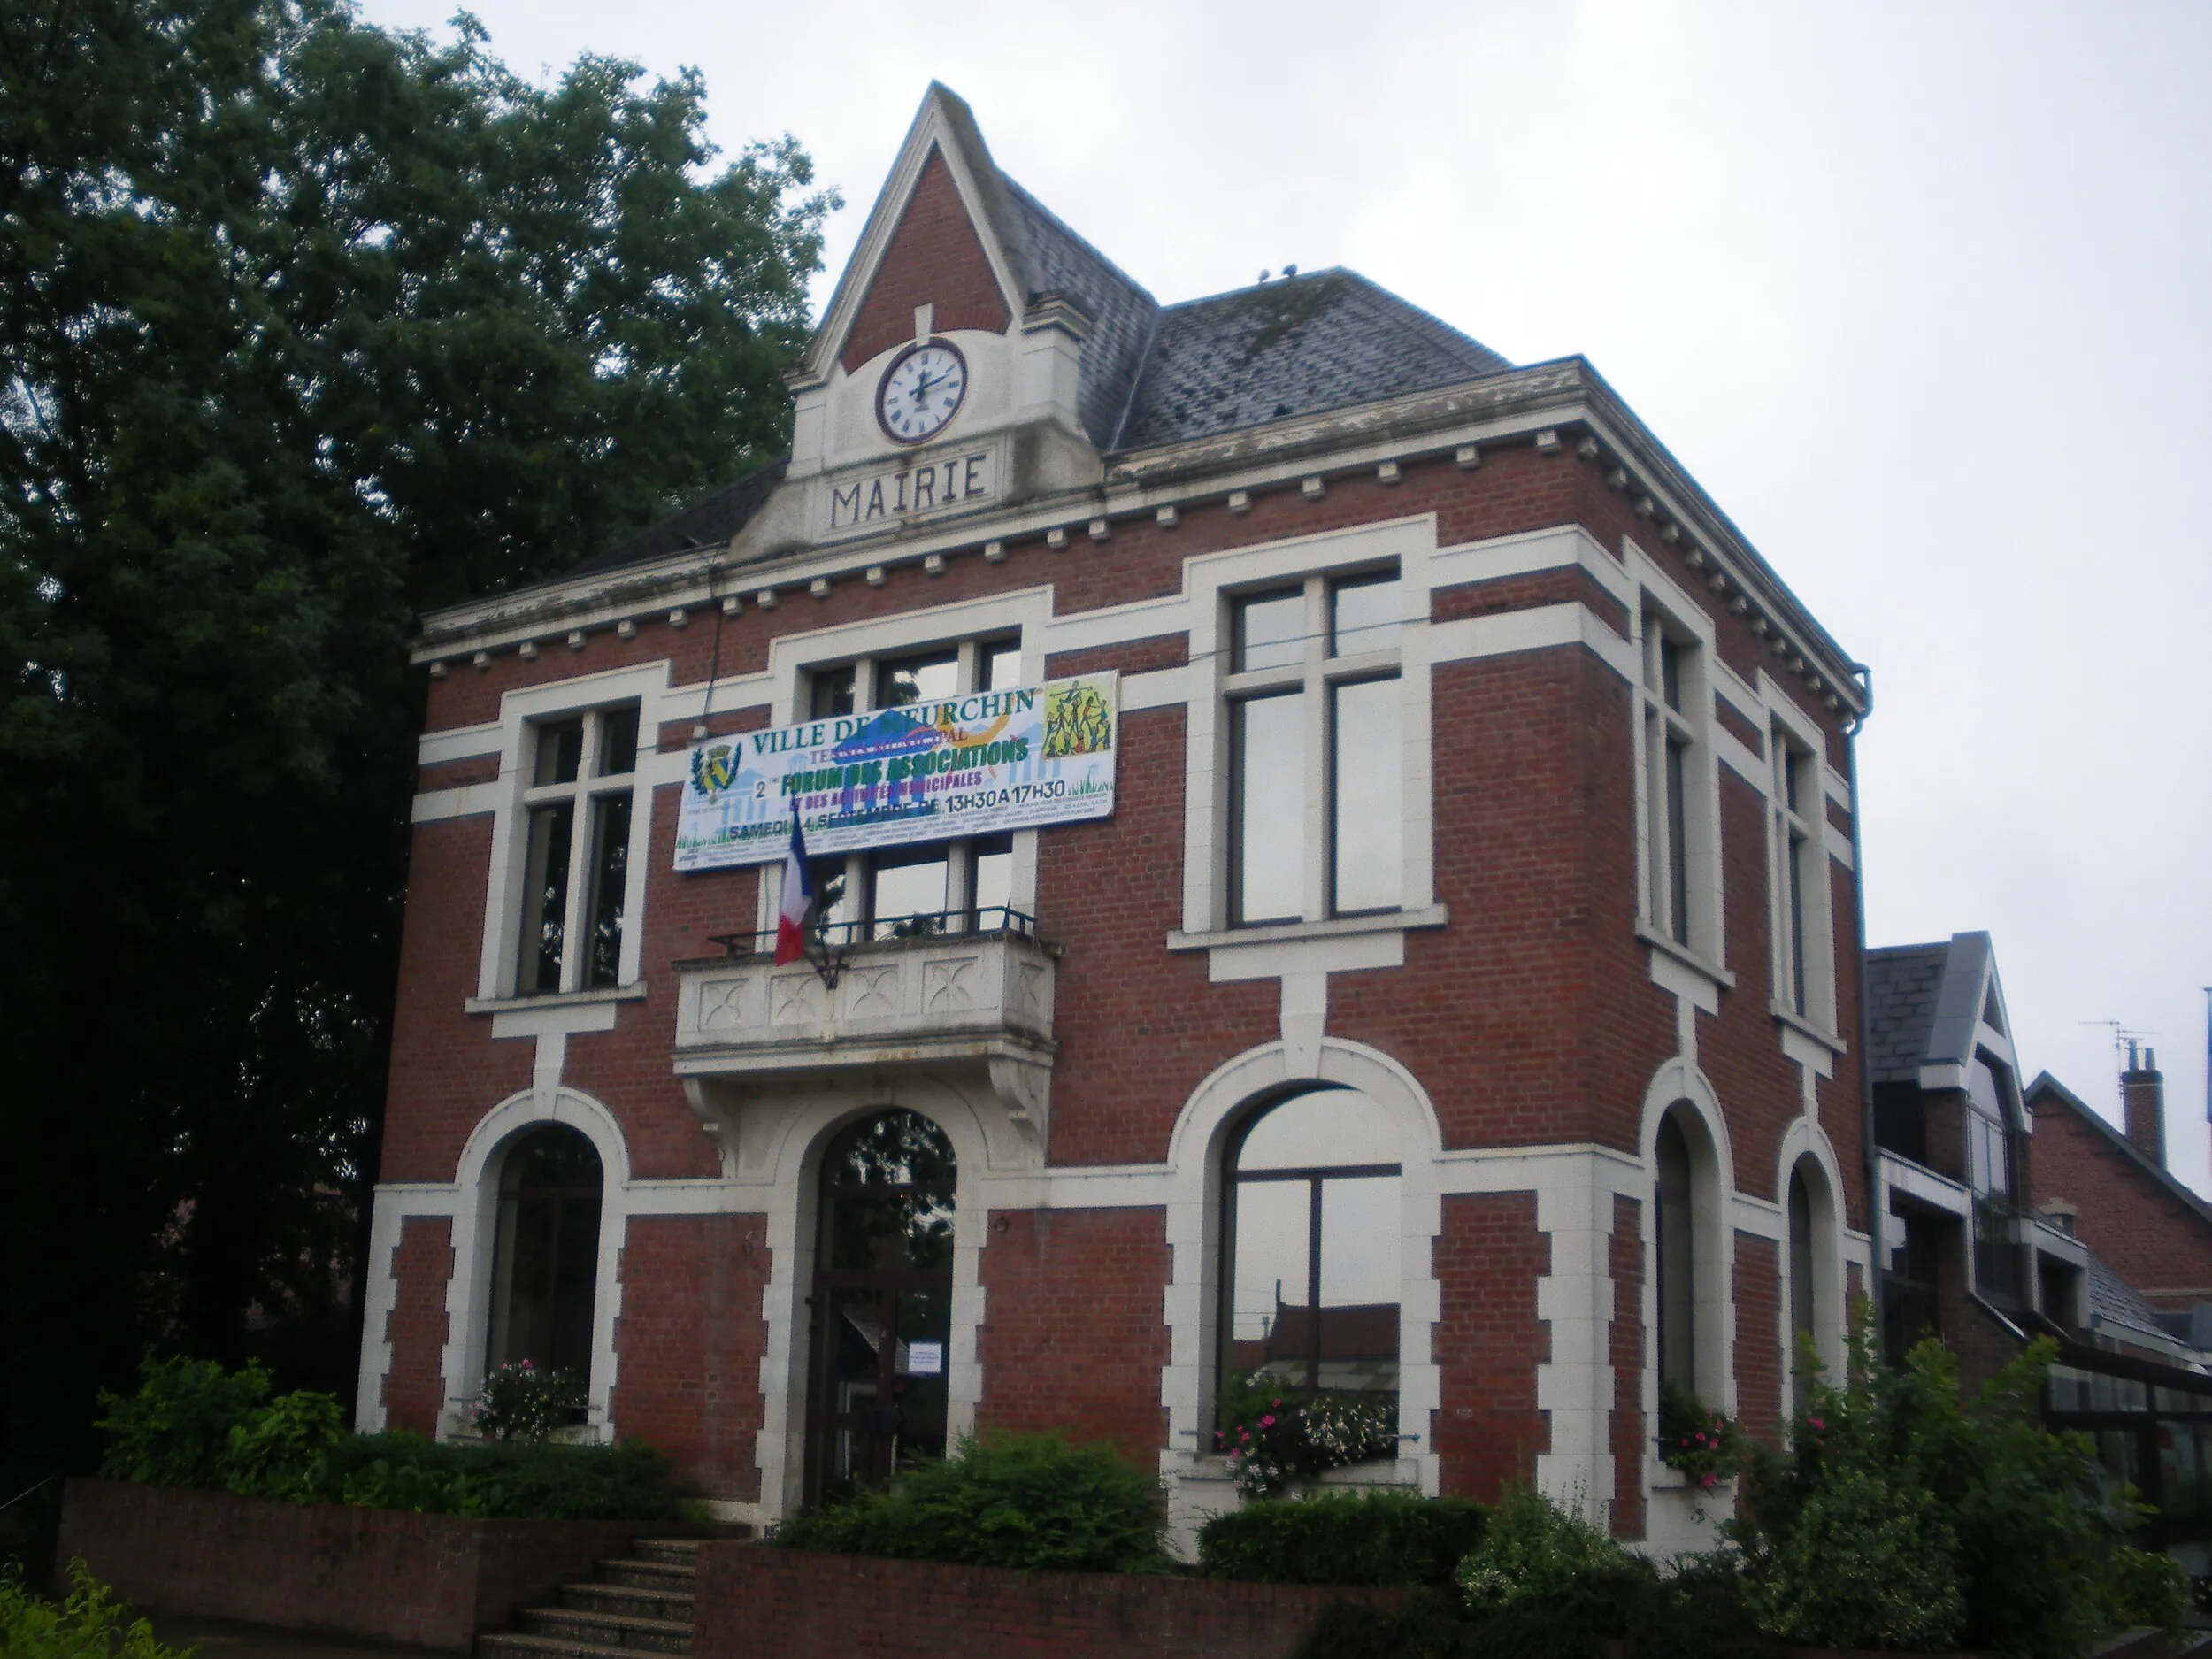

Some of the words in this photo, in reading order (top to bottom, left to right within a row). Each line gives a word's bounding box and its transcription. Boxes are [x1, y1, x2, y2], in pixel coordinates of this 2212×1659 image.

[831, 454, 987, 528] MAIRIE
[753, 724, 825, 754] VILLE
[883, 687, 1035, 729] EURCHIN
[781, 766, 843, 796] FORUM
[886, 737, 1029, 781] ASSOCIATIONS
[729, 819, 787, 840] SAMEDI
[945, 790, 997, 813] 13H30
[998, 789, 1010, 804] A
[1012, 780, 1065, 803] 17H30
